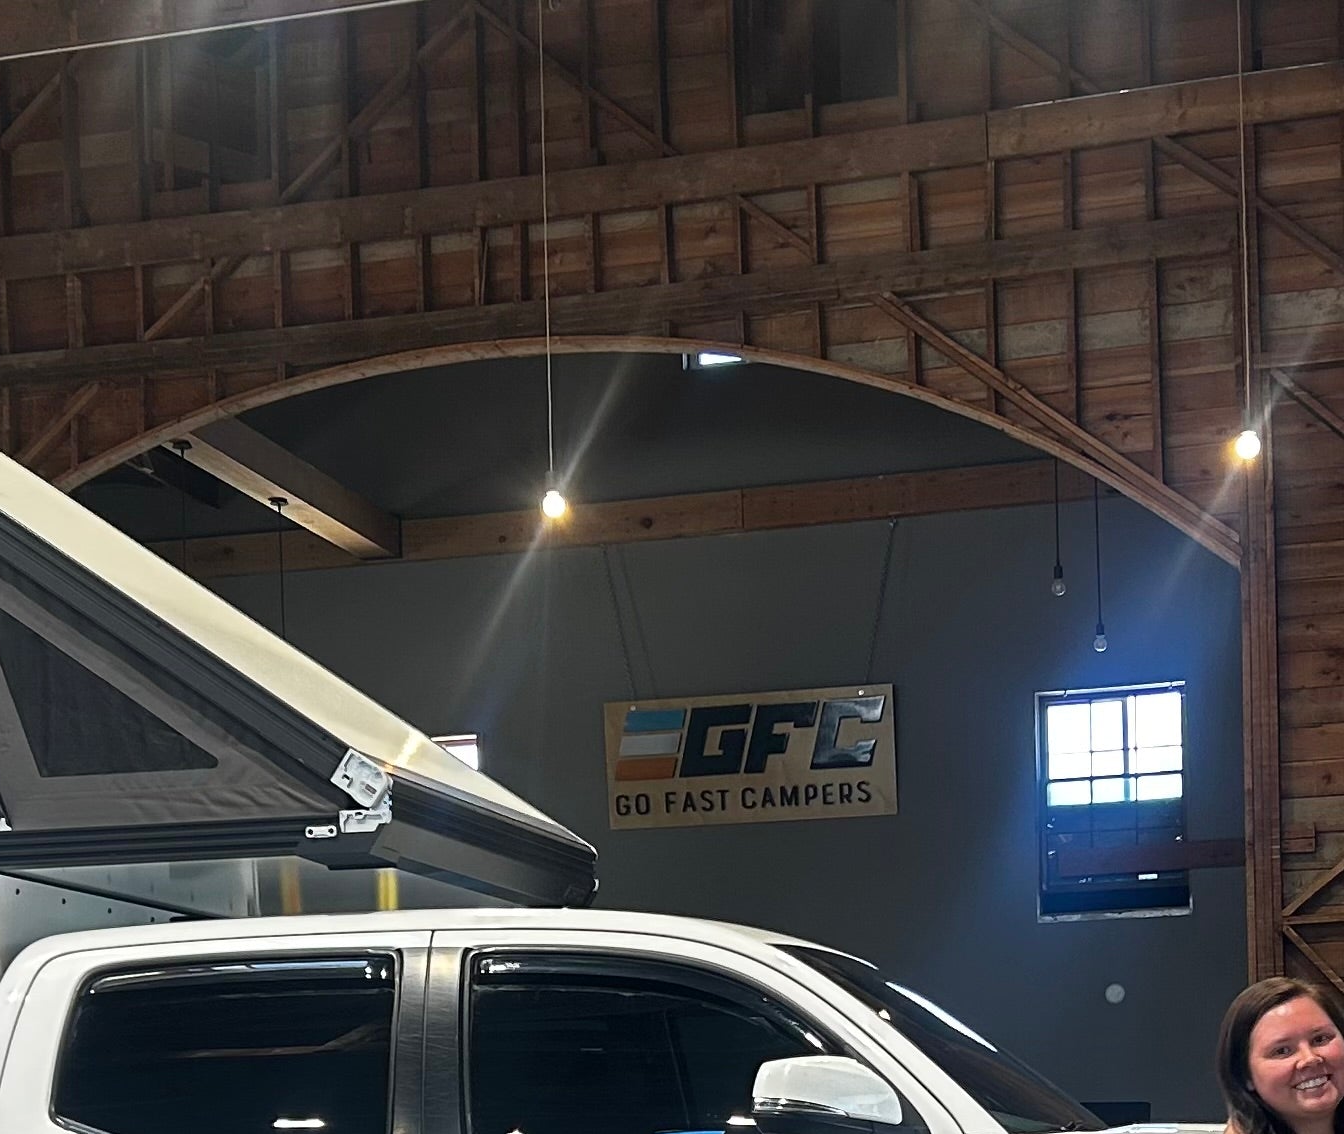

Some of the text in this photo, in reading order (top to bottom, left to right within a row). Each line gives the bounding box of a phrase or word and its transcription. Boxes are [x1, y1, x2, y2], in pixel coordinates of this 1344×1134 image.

[680, 696, 885, 778] GFC
[615, 780, 873, 817] GO FAST CAMPERS
